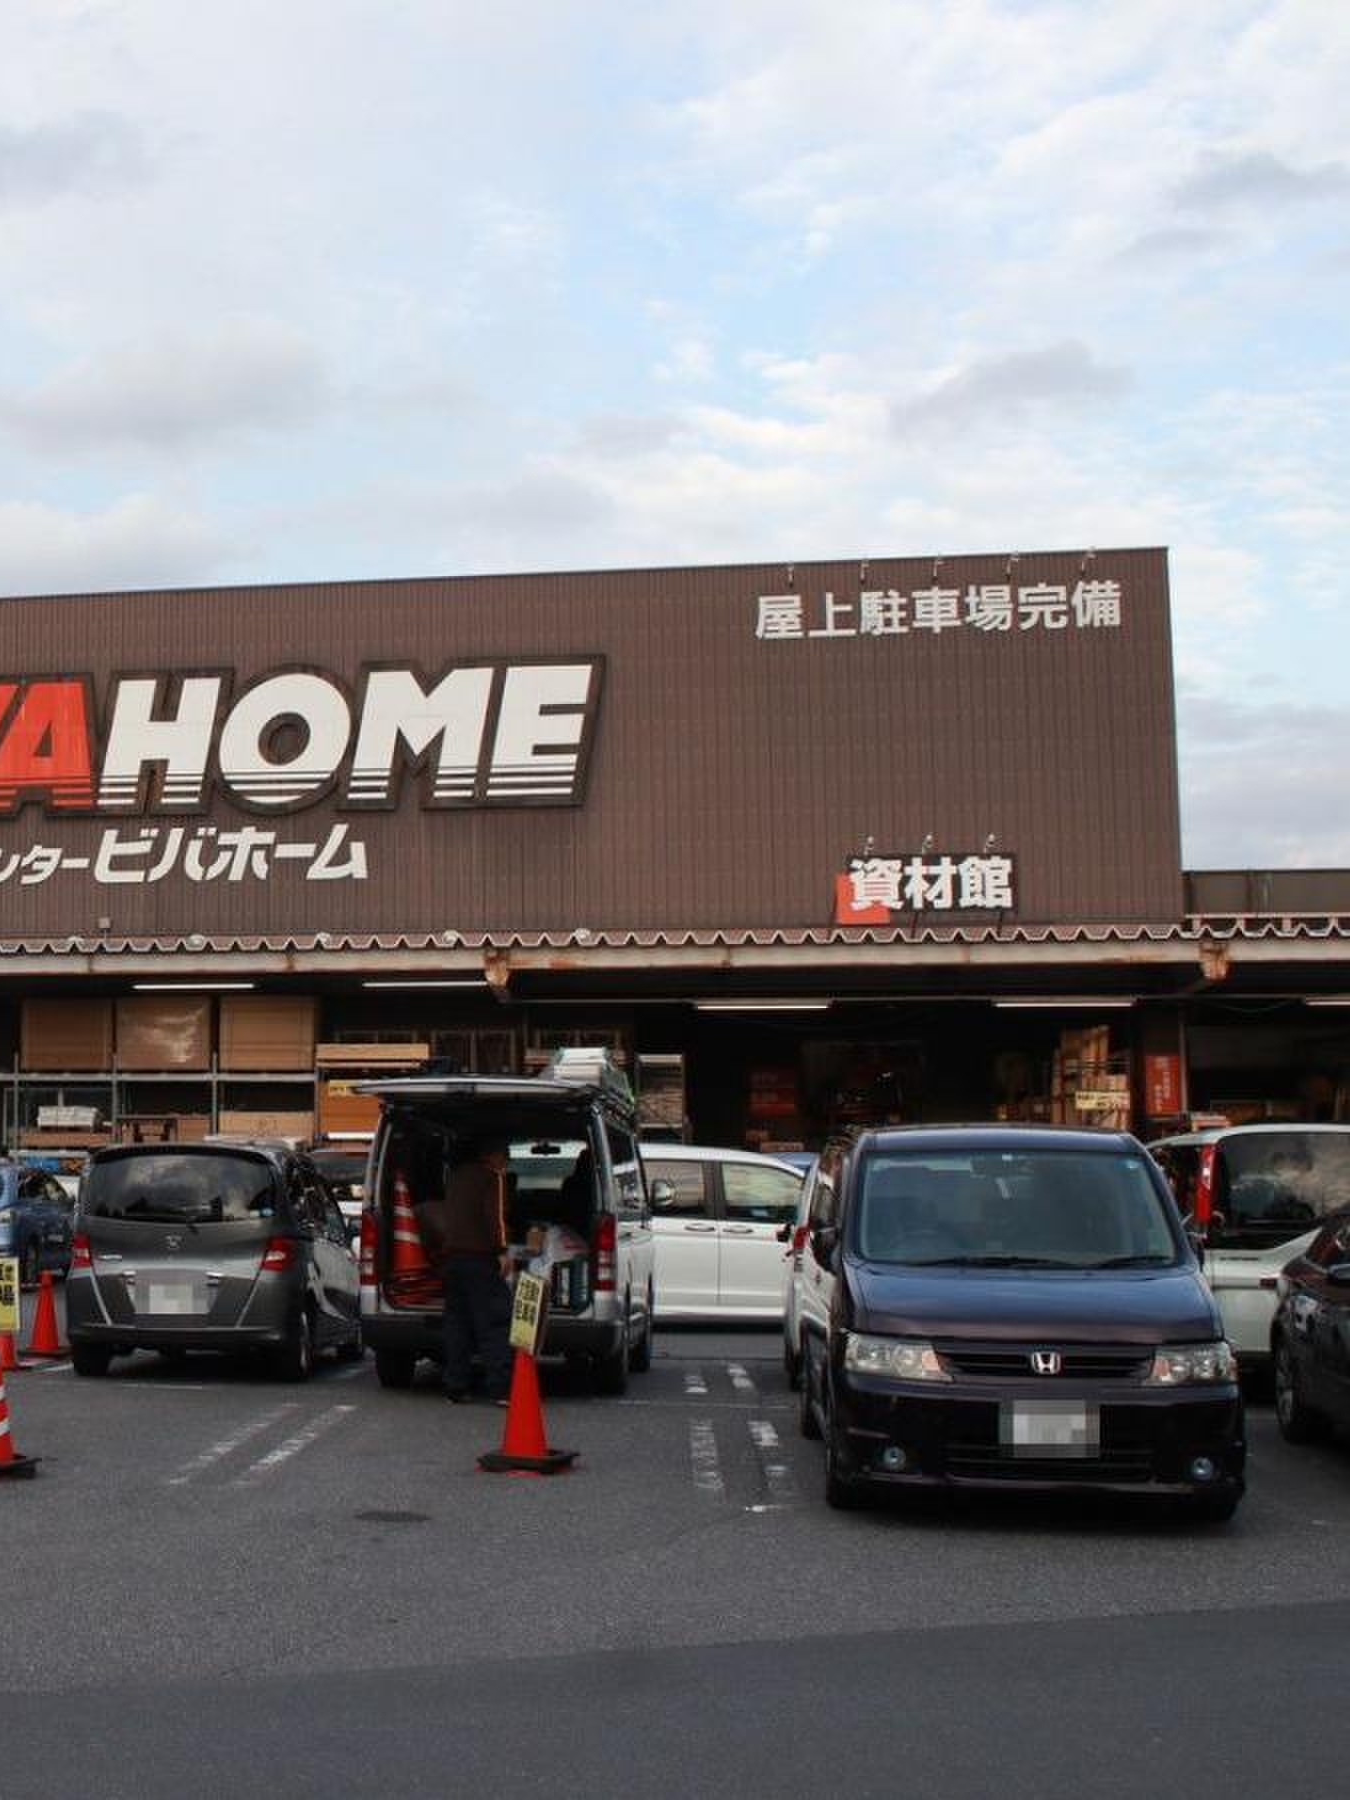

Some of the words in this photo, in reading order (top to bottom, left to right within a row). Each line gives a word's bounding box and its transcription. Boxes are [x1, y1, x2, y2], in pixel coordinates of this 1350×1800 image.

[756, 580, 1122, 640] 屋上駐車場完備
[850, 856, 1013, 910] 資材館
